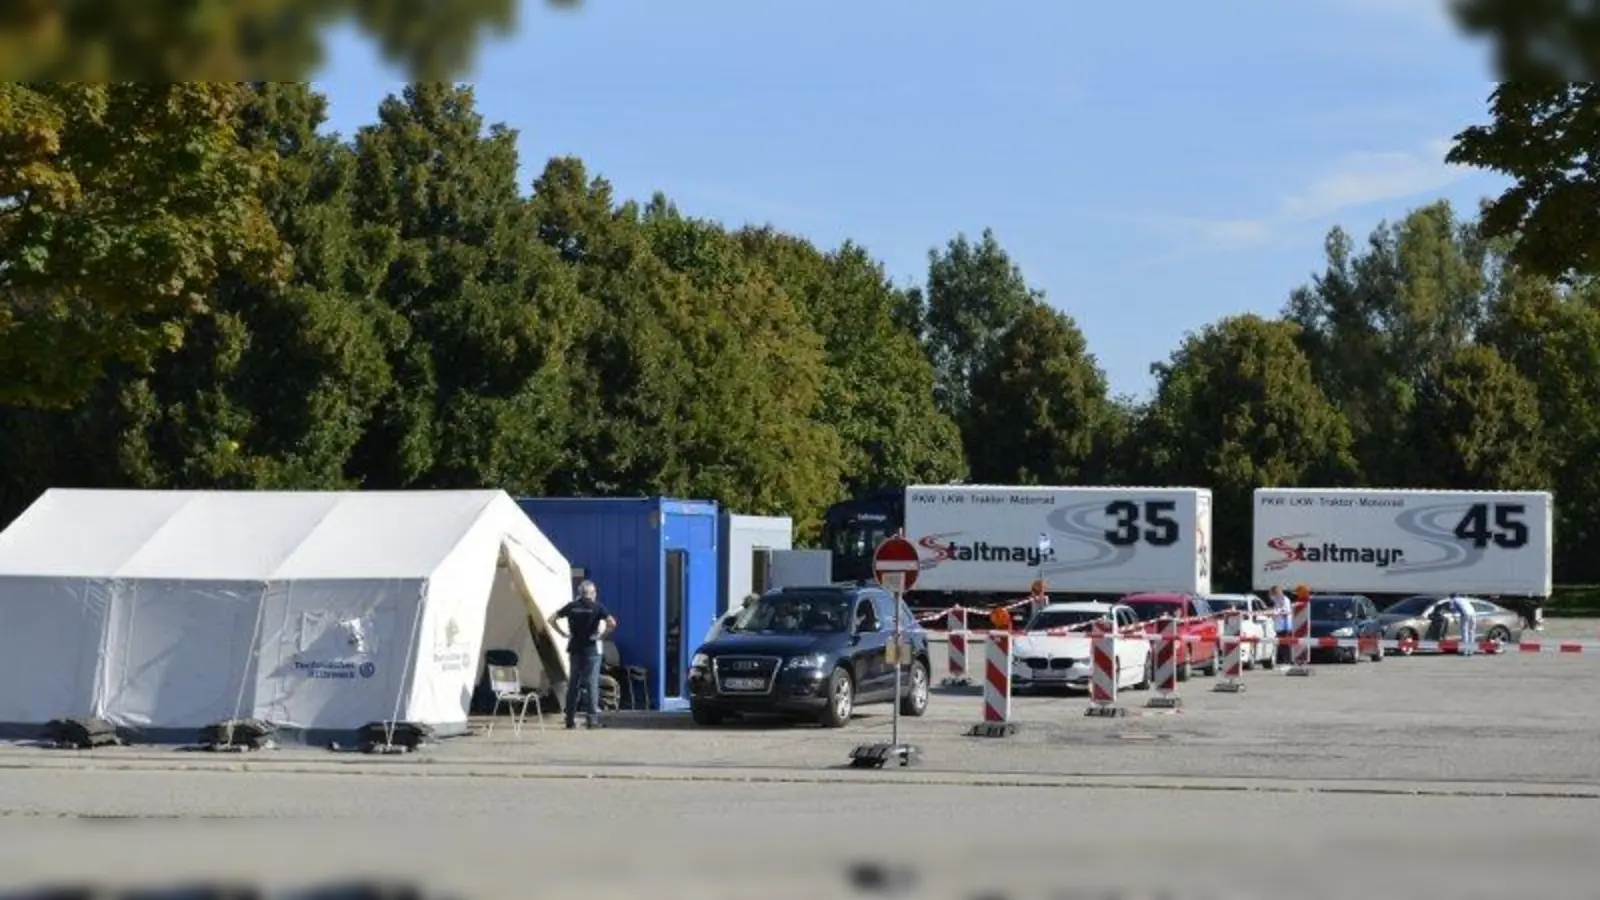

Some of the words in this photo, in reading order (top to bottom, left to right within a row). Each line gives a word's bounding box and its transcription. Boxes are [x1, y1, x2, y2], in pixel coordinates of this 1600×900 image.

[911, 494, 936, 504] PKW
[941, 495, 964, 505] LKW
[1010, 495, 1055, 505] Motorrad
[1261, 496, 1284, 505] PKW
[1290, 497, 1313, 506] LKW
[1320, 496, 1352, 507] Traktor
[1359, 497, 1404, 507] Motorrad
[1104, 500, 1179, 547] 35
[1455, 504, 1528, 549] 45
[1267, 536, 1404, 567] Staltmayr
